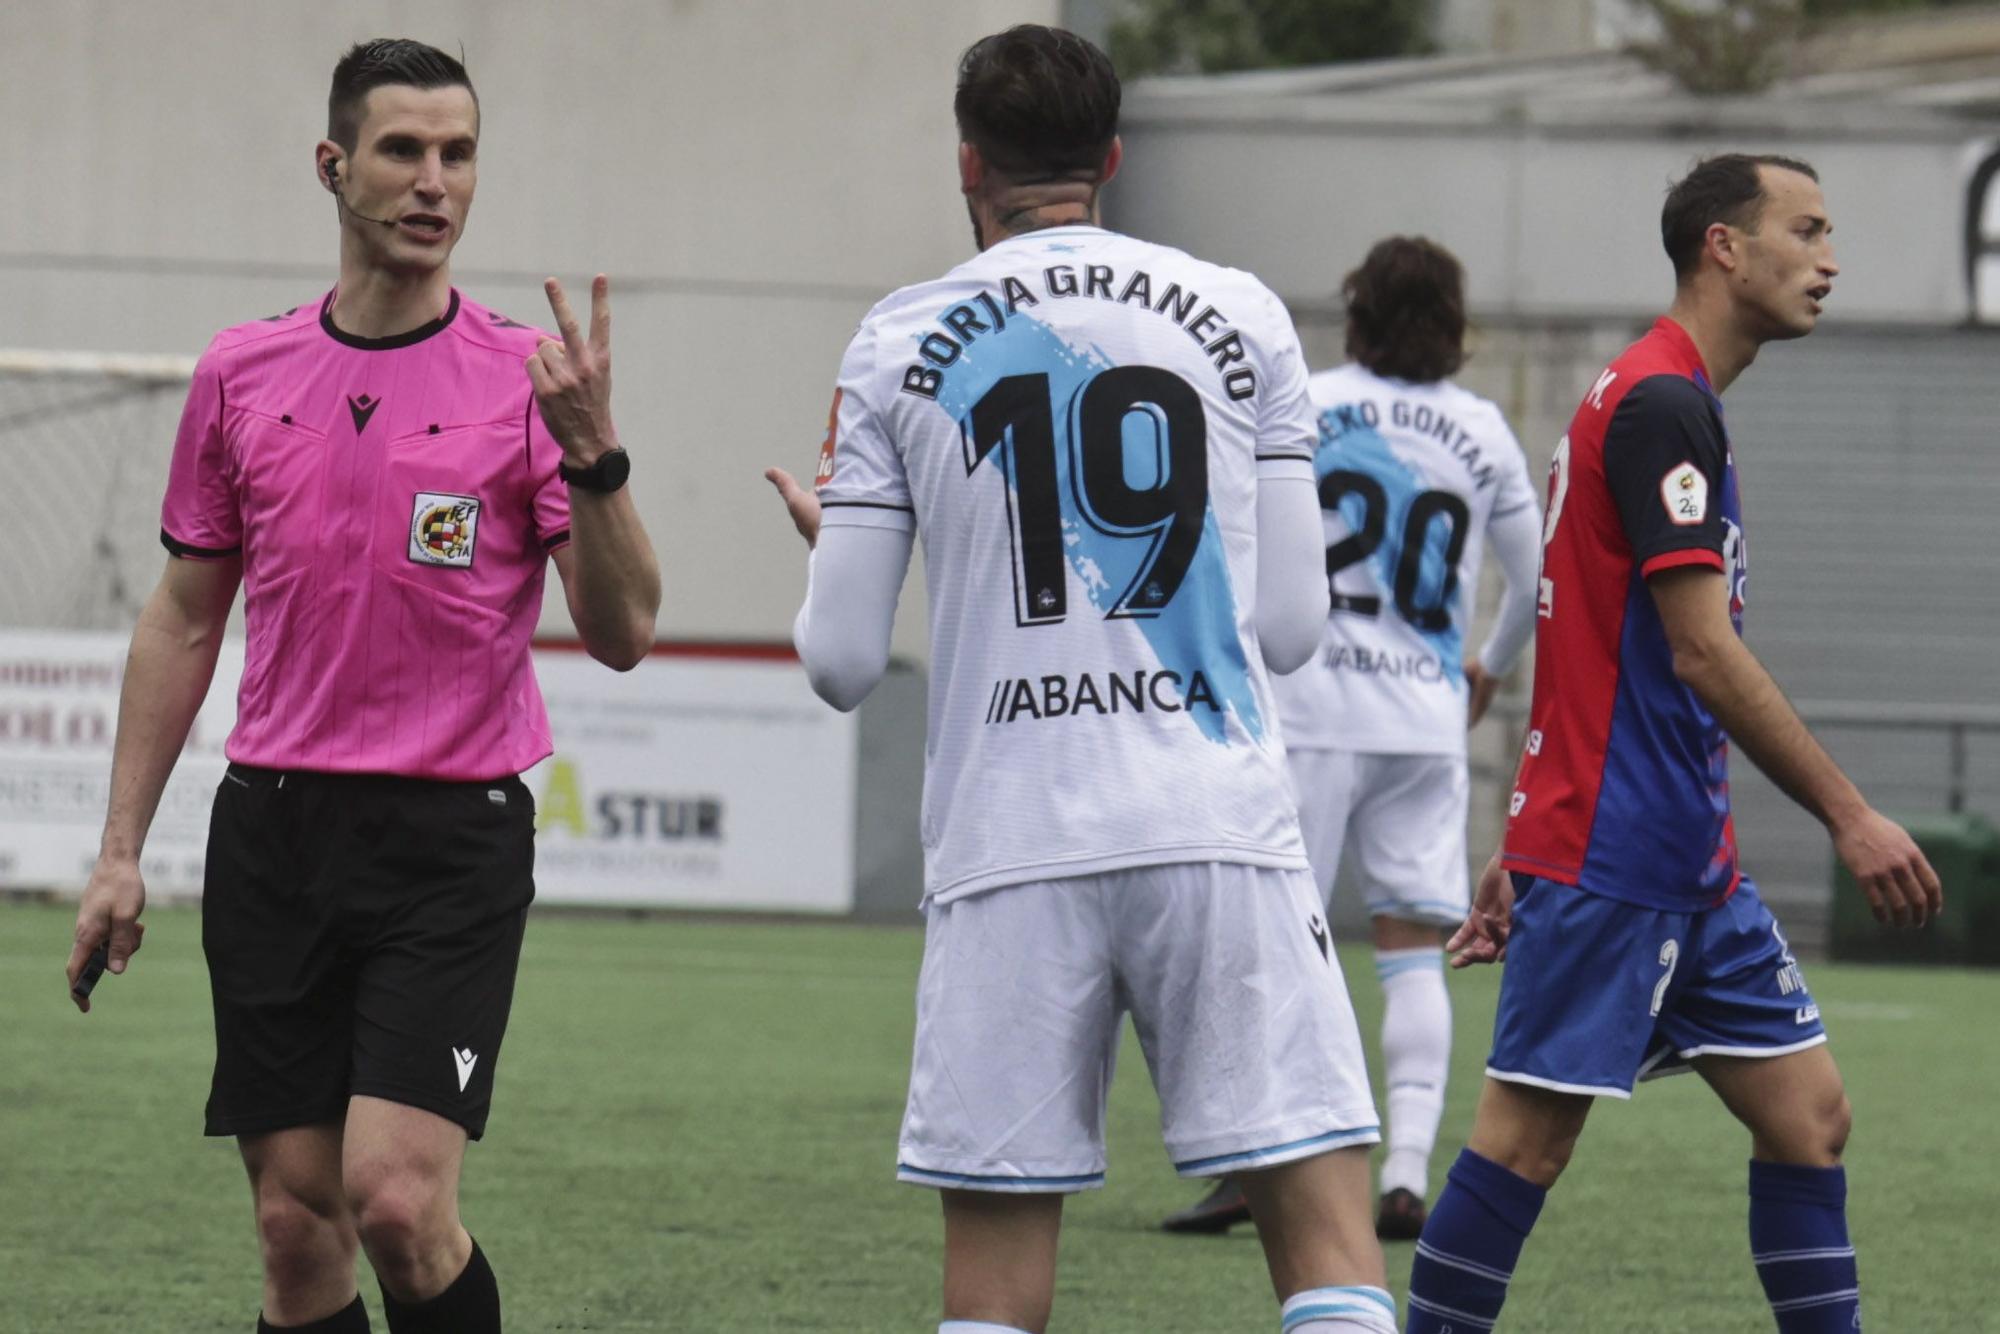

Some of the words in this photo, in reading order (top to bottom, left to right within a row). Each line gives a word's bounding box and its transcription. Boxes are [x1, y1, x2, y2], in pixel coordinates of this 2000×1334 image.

[900, 276, 1039, 401] BORJA
[1043, 264, 1257, 401] GRANERO
[960, 365, 1208, 627] 19
[1318, 468, 1470, 633] 20
[536, 757, 724, 841] ASTUR
[1649, 938, 1679, 1017] 2
